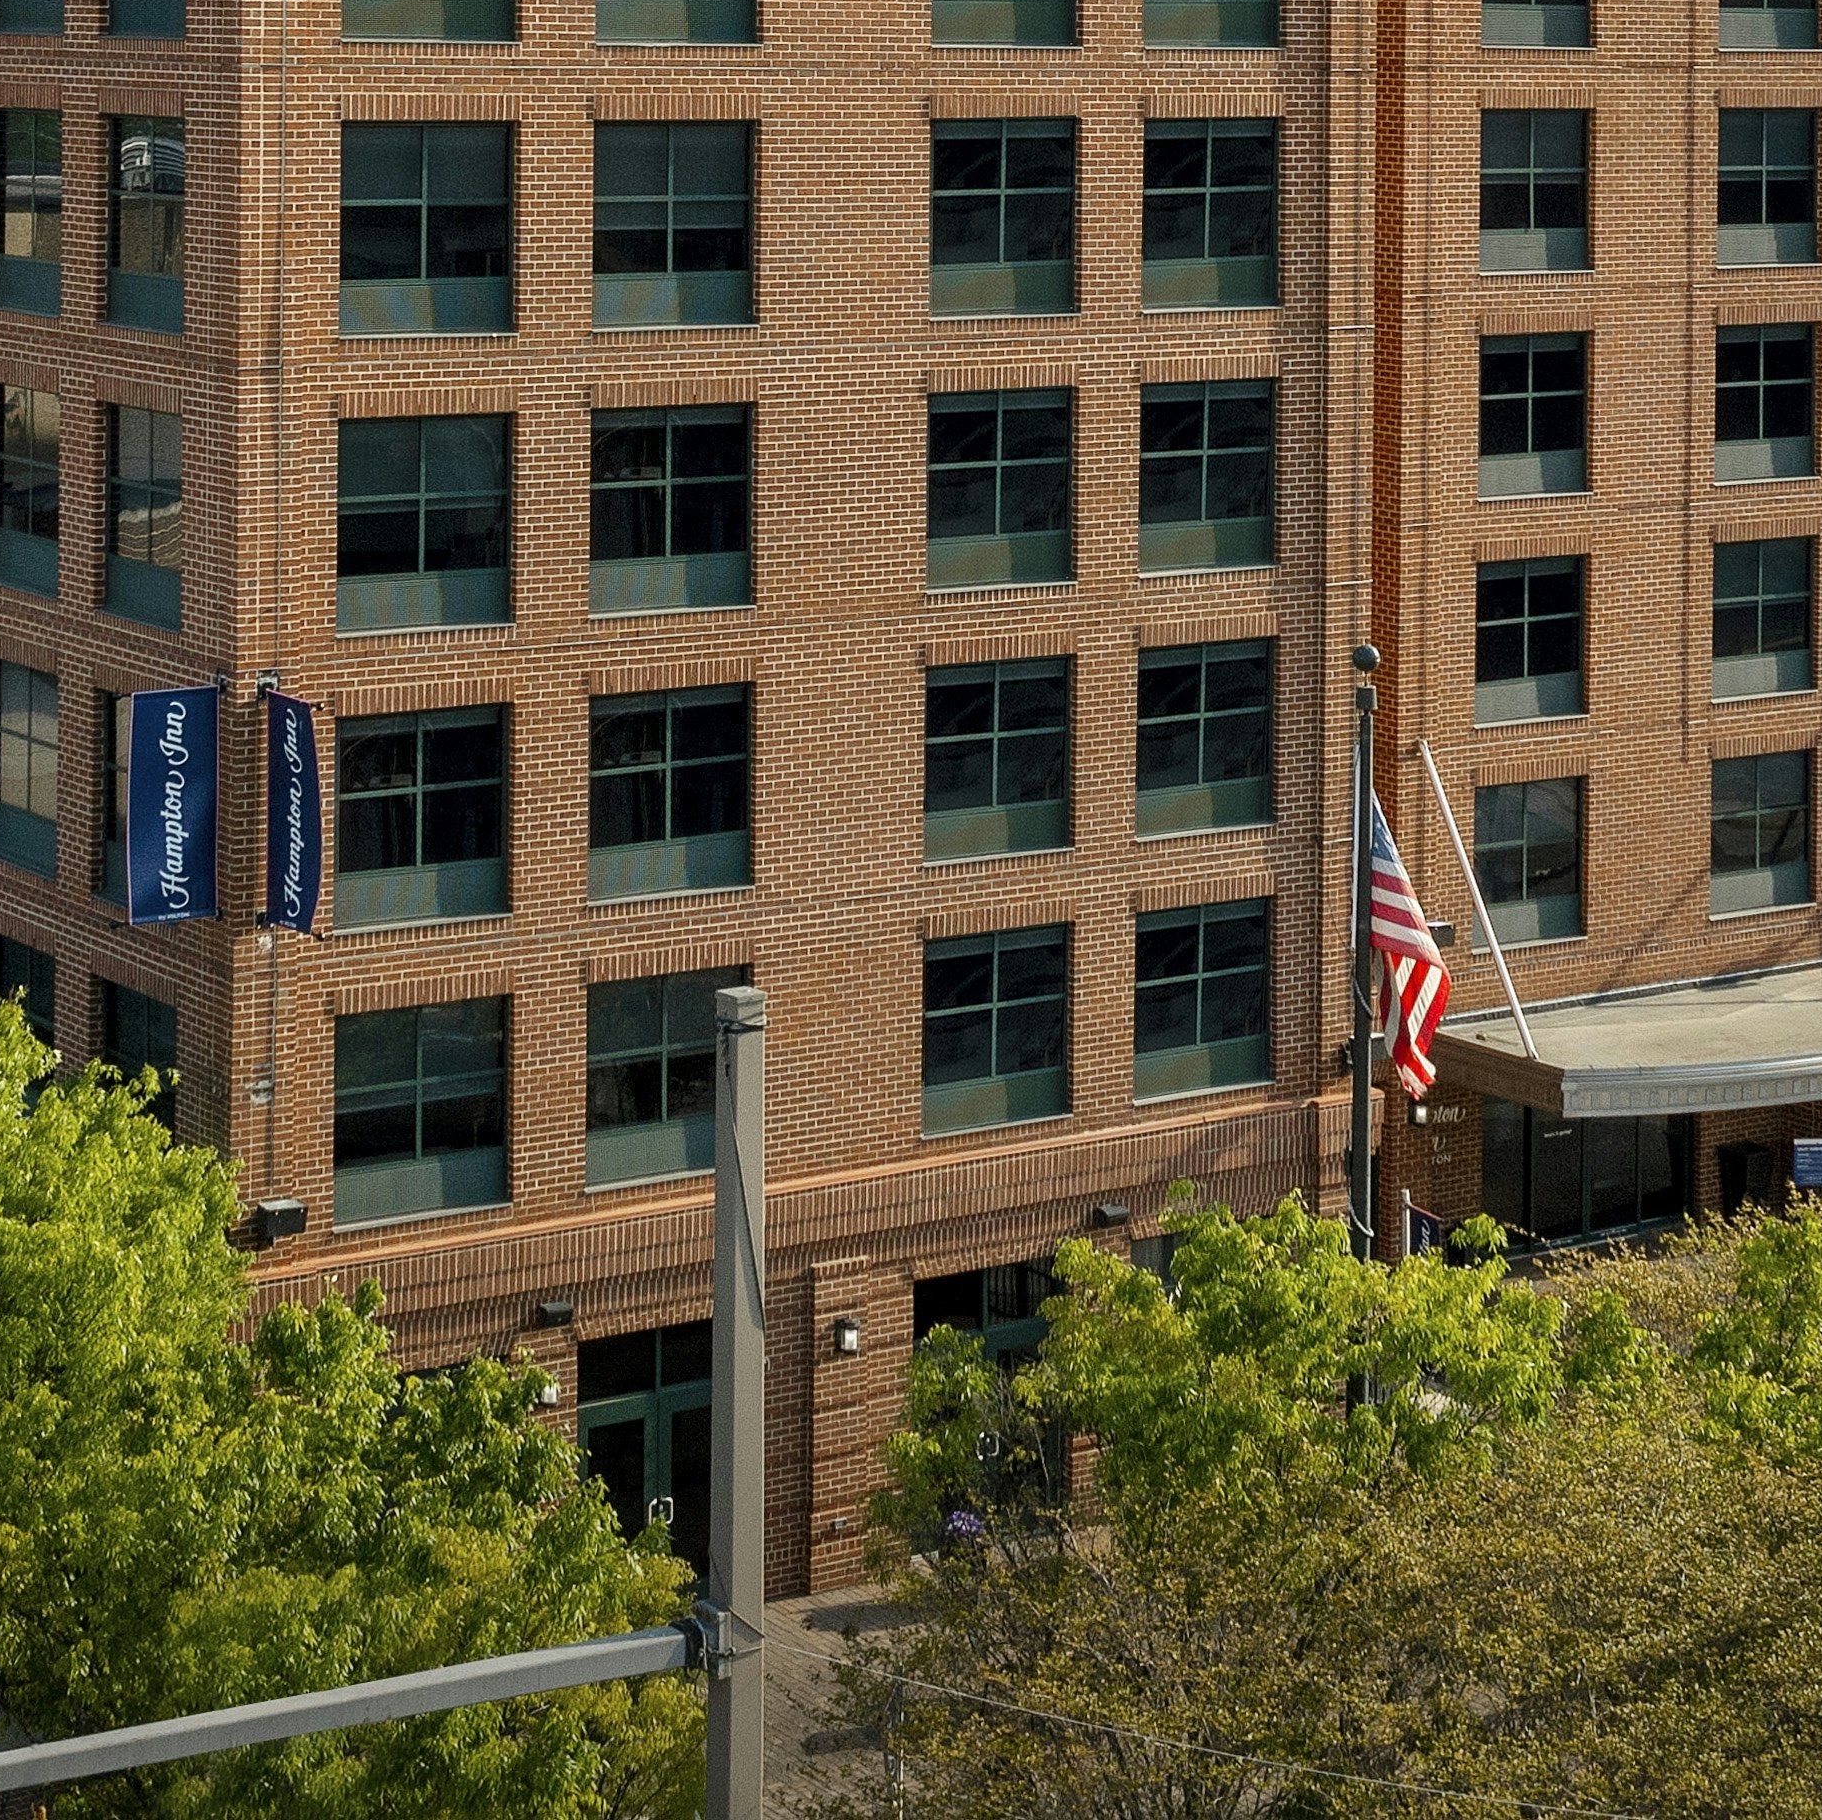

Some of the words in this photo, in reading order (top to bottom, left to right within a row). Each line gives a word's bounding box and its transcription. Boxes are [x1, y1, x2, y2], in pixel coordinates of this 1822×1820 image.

[159, 701, 189, 766] Inn
[283, 708, 302, 774] Inn
[161, 769, 189, 910] Hampton
[283, 777, 305, 918] Hampton
